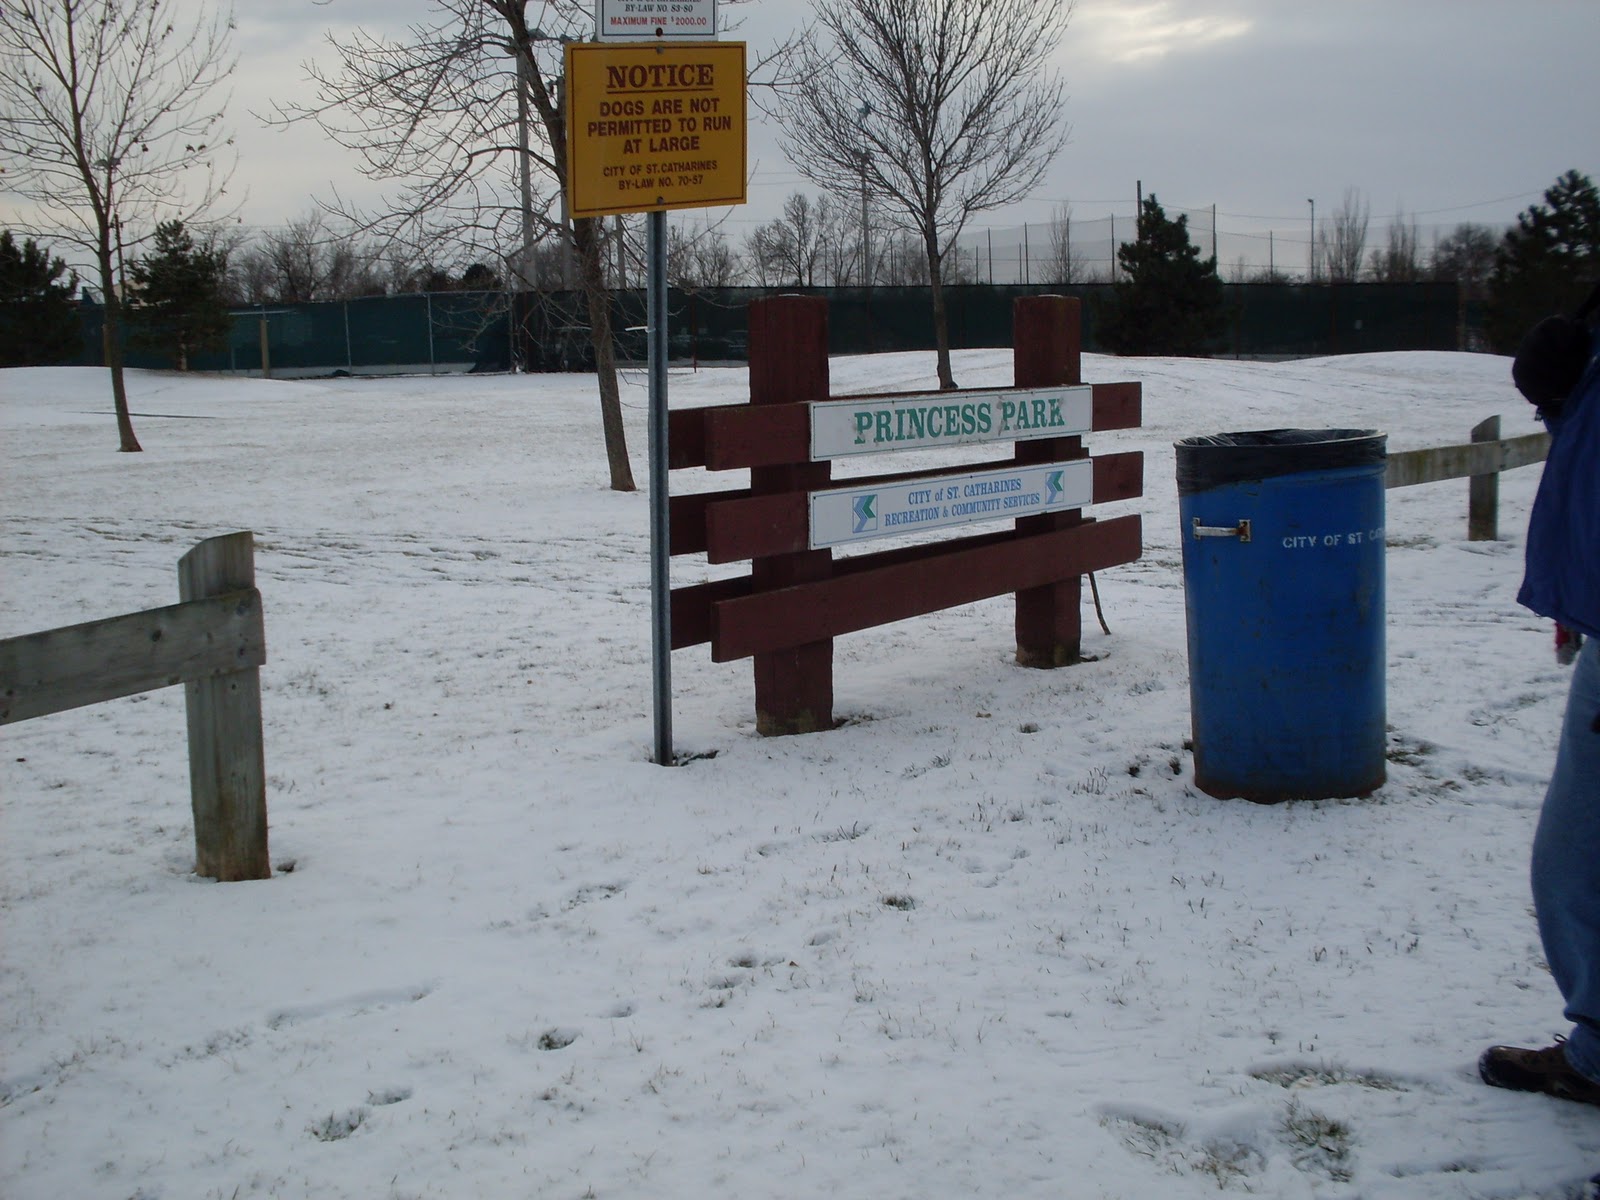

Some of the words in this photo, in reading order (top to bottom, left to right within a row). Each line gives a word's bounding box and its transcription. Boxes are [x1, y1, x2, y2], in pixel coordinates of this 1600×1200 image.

[610, 16, 648, 26] MAXIMUM
[650, 16, 667, 26] FINE
[606, 63, 714, 89] NOTICE
[600, 100, 644, 117] DOGS
[652, 99, 683, 115] ARE
[690, 98, 720, 114] NOT
[588, 119, 671, 137] PERMITTED
[678, 117, 697, 132] TO
[703, 116, 731, 131] RUN
[623, 139, 642, 154] AT
[650, 136, 700, 153] LARGE
[603, 165, 625, 177] CITY
[629, 164, 642, 176] OF
[619, 177, 654, 190] BY-LAW
[658, 176, 674, 188] NO.
[678, 174, 704, 186] 70-57
[854, 402, 992, 445] PRINCESS
[1002, 398, 1066, 432] PARK
[908, 489, 932, 505] CITY
[934, 490, 944, 501] of
[946, 487, 960, 500] ST.
[964, 478, 1022, 497] CATHARINES
[885, 506, 940, 527] RECREATION
[942, 507, 949, 518] &
[951, 497, 1001, 517] COMMUNITY
[1003, 492, 1040, 509] SERVICES
[1282, 535, 1317, 548] CITY
[1323, 534, 1342, 546] OF
[1348, 531, 1363, 545] ST
